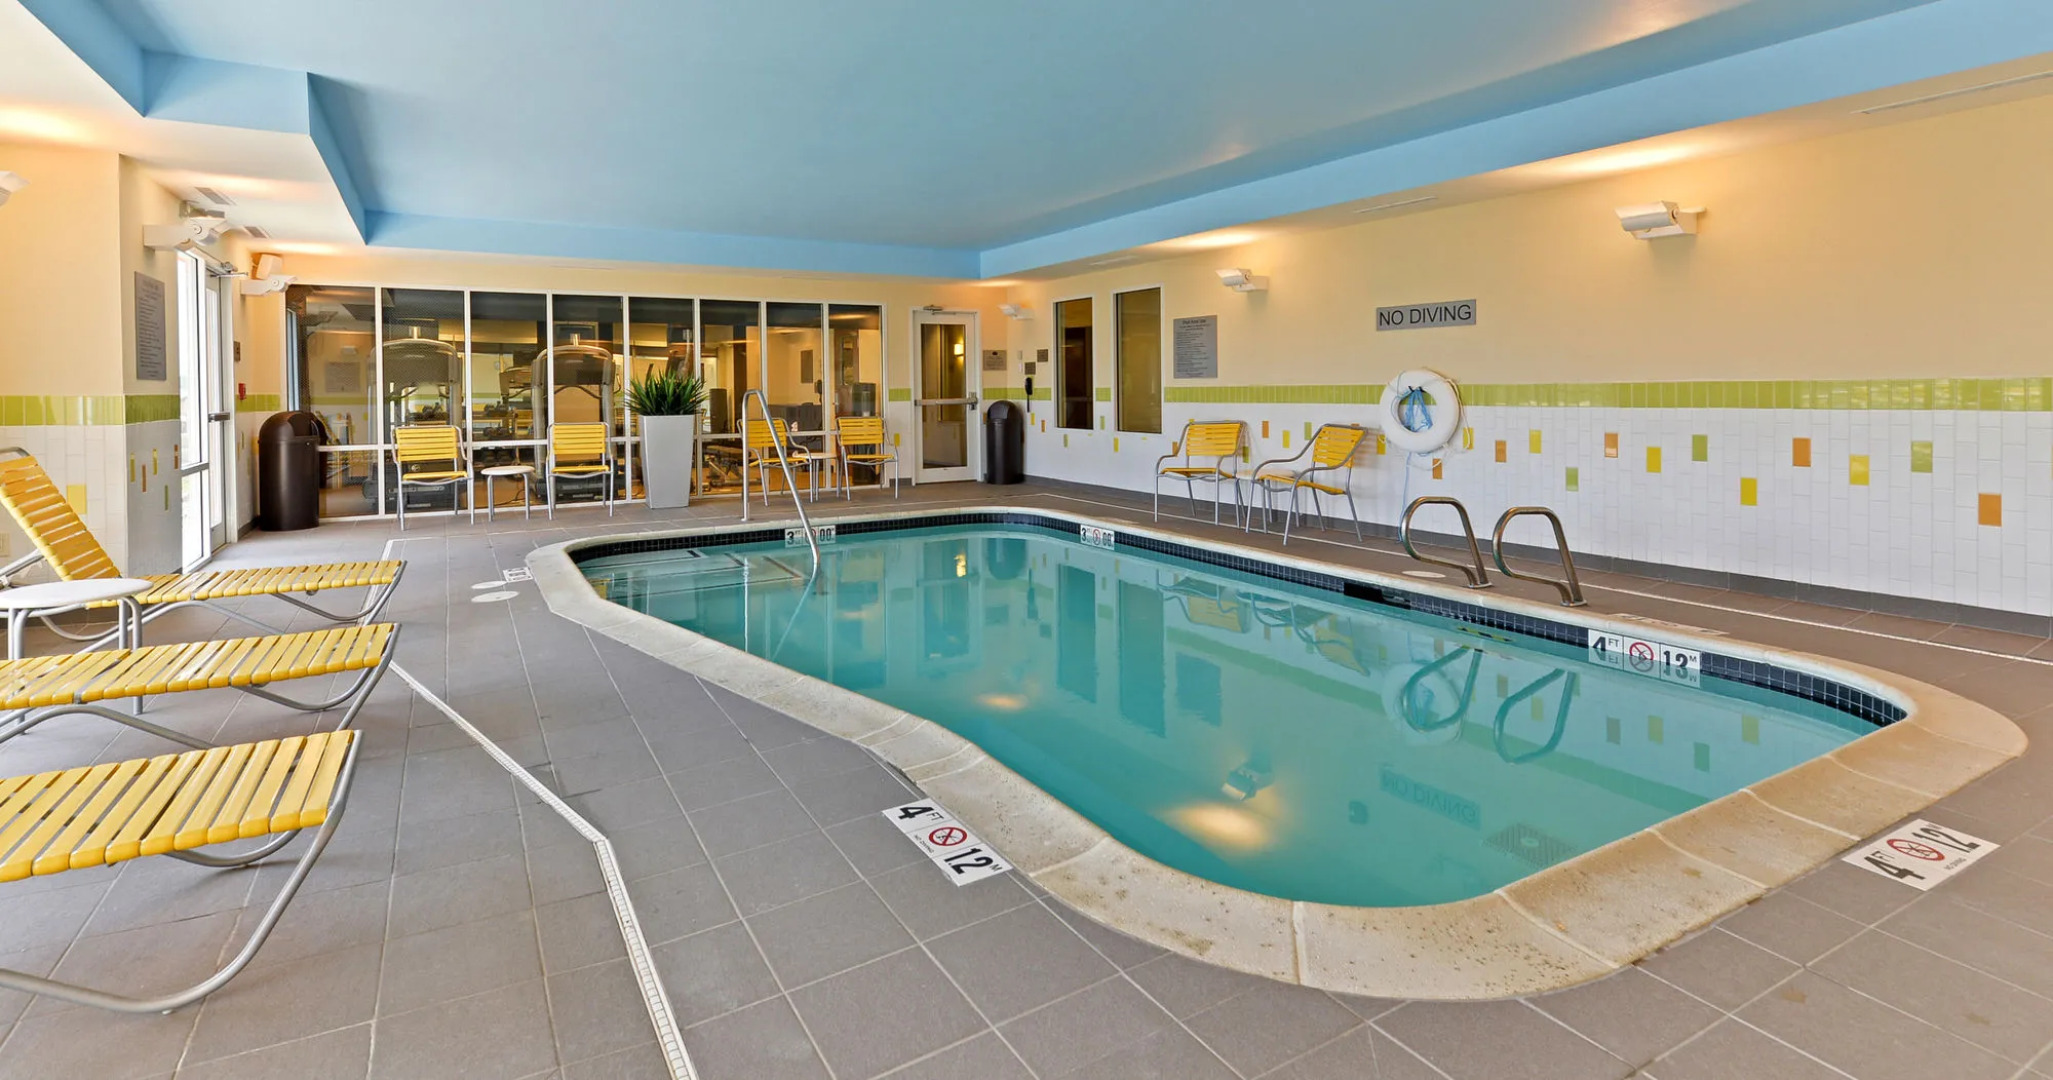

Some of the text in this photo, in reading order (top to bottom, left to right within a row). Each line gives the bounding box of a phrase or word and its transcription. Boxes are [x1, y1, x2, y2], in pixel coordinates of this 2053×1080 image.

[1379, 304, 1472, 326] NO DIVING
[1608, 638, 1619, 648] FT
[898, 806, 945, 821] 4 FT
[989, 864, 1003, 872] M
[1863, 850, 1927, 880] 4 FT
